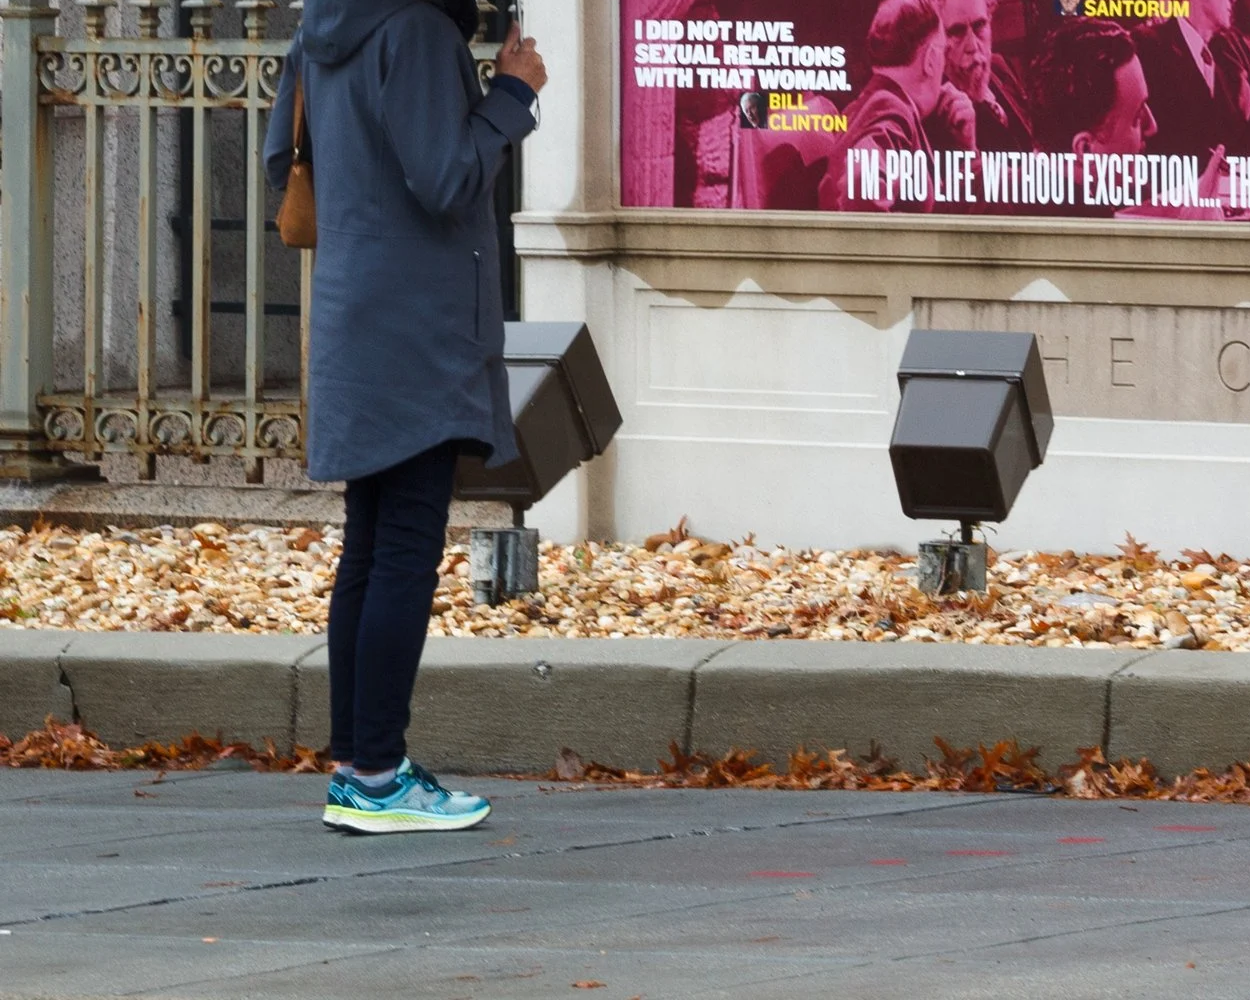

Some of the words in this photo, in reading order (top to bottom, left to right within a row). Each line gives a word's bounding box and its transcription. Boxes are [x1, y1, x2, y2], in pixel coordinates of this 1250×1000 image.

[1085, 0, 1189, 17] SANTORUM
[649, 20, 684, 40] DID
[688, 21, 732, 41] NOT
[736, 22, 793, 42] HAVE
[635, 44, 720, 64] SEXUAL
[724, 45, 845, 66] RELATIONS
[635, 67, 693, 87] WITH
[697, 68, 754, 88] THAT
[758, 69, 851, 90] WOMAN.
[769, 93, 806, 110] BILL
[769, 113, 847, 132] CLINTON
[848, 149, 879, 199] I'M
[886, 150, 927, 201] PRO
[934, 151, 976, 201] LIFE
[982, 152, 1076, 204] WITHOUT
[1041, 335, 1135, 387] HE
